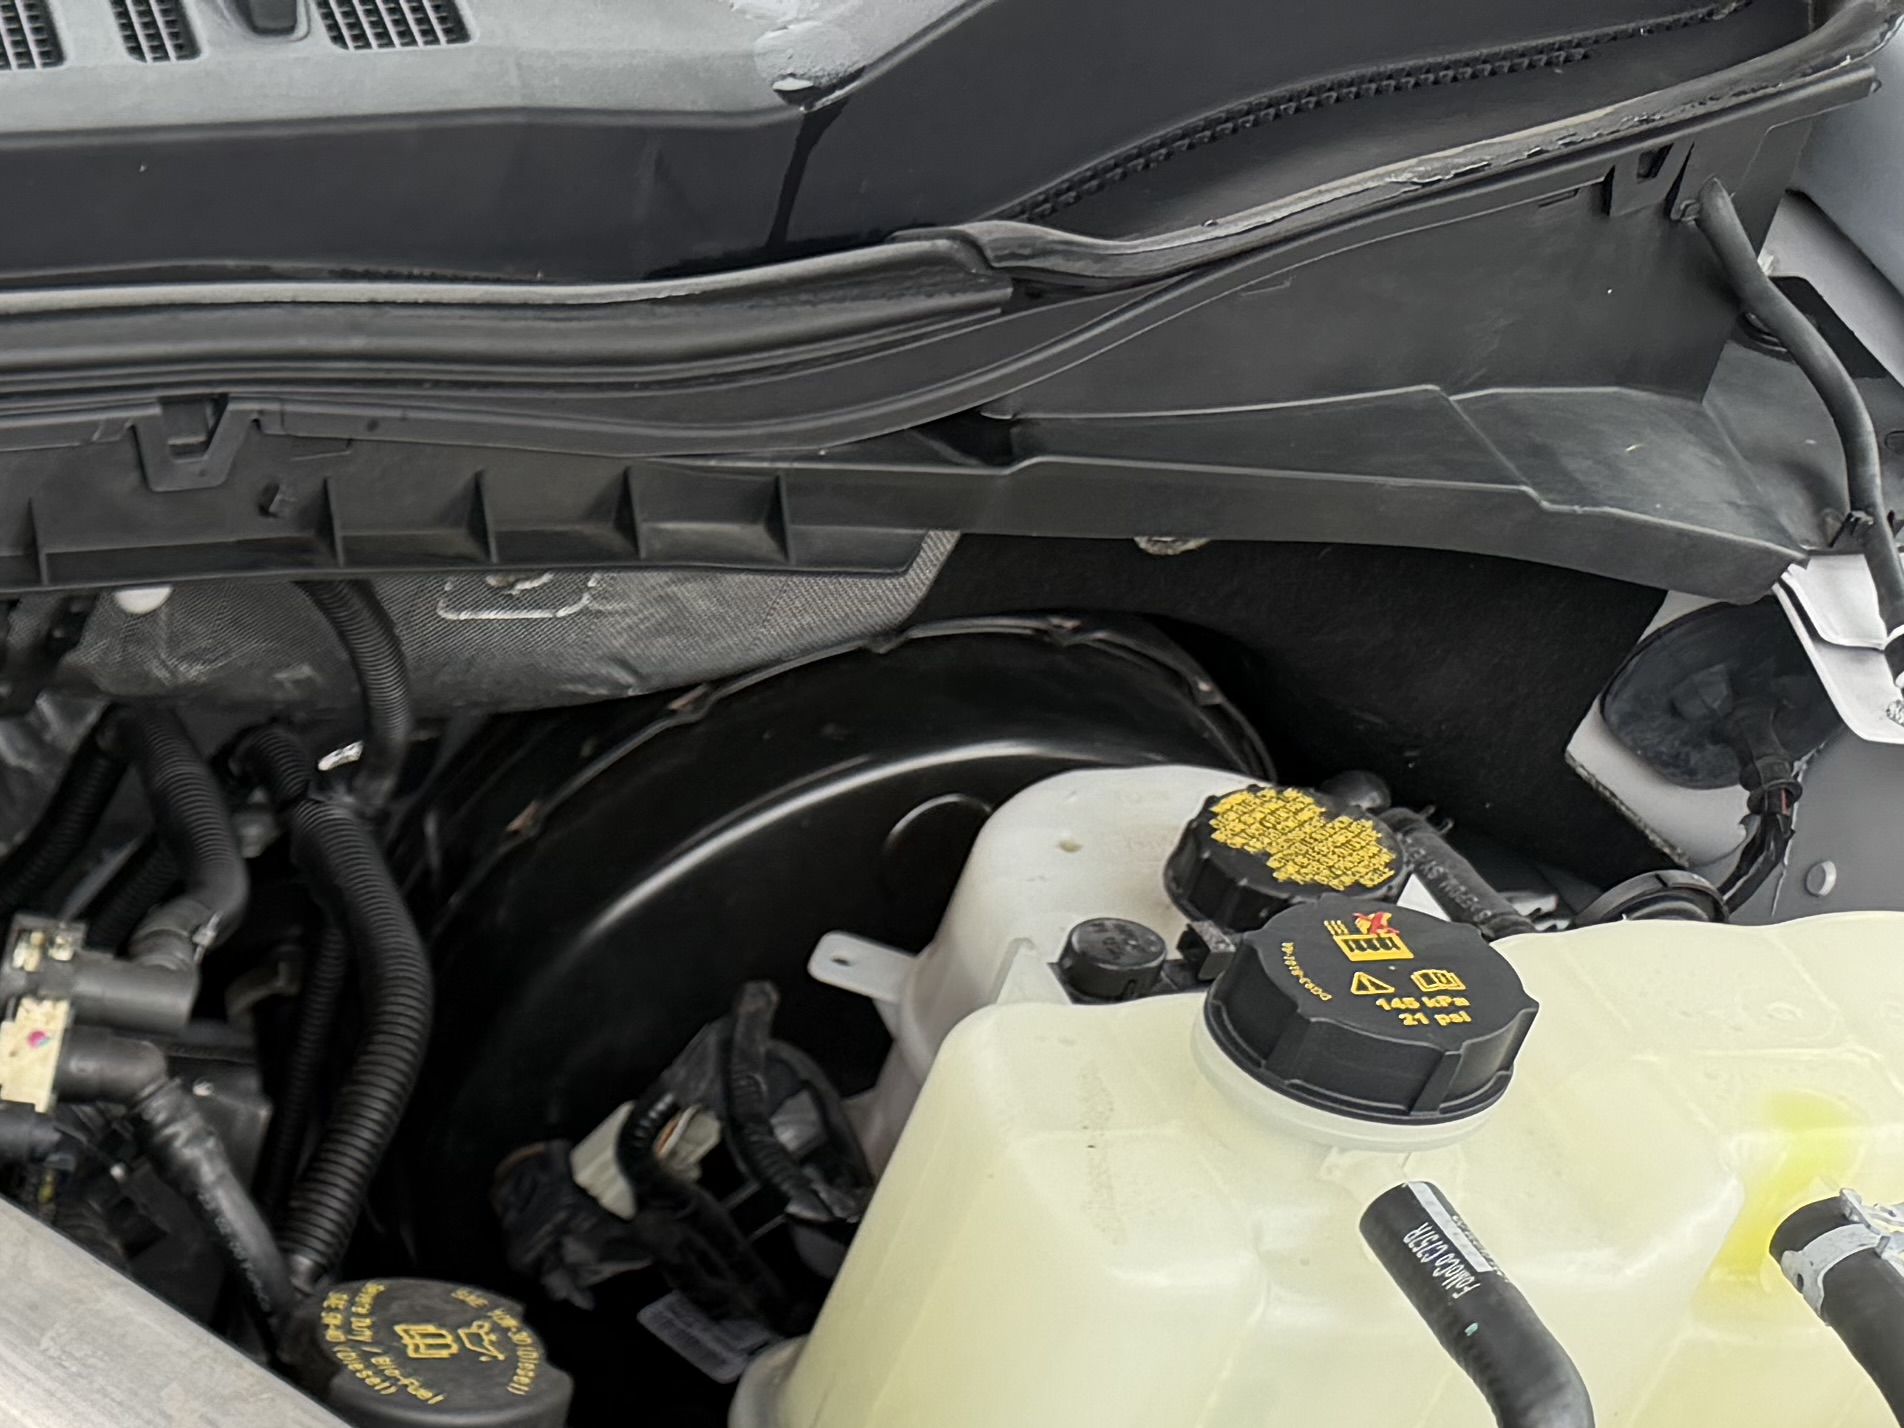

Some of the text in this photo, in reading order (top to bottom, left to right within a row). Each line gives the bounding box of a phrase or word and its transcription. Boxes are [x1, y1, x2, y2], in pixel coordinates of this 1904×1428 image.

[1376, 995, 1471, 1011] 145 kPa
[1398, 1010, 1472, 1026] 21 psi
[1403, 1221, 1449, 1264] C757R
[1432, 1252, 1481, 1299] FoMoCo
